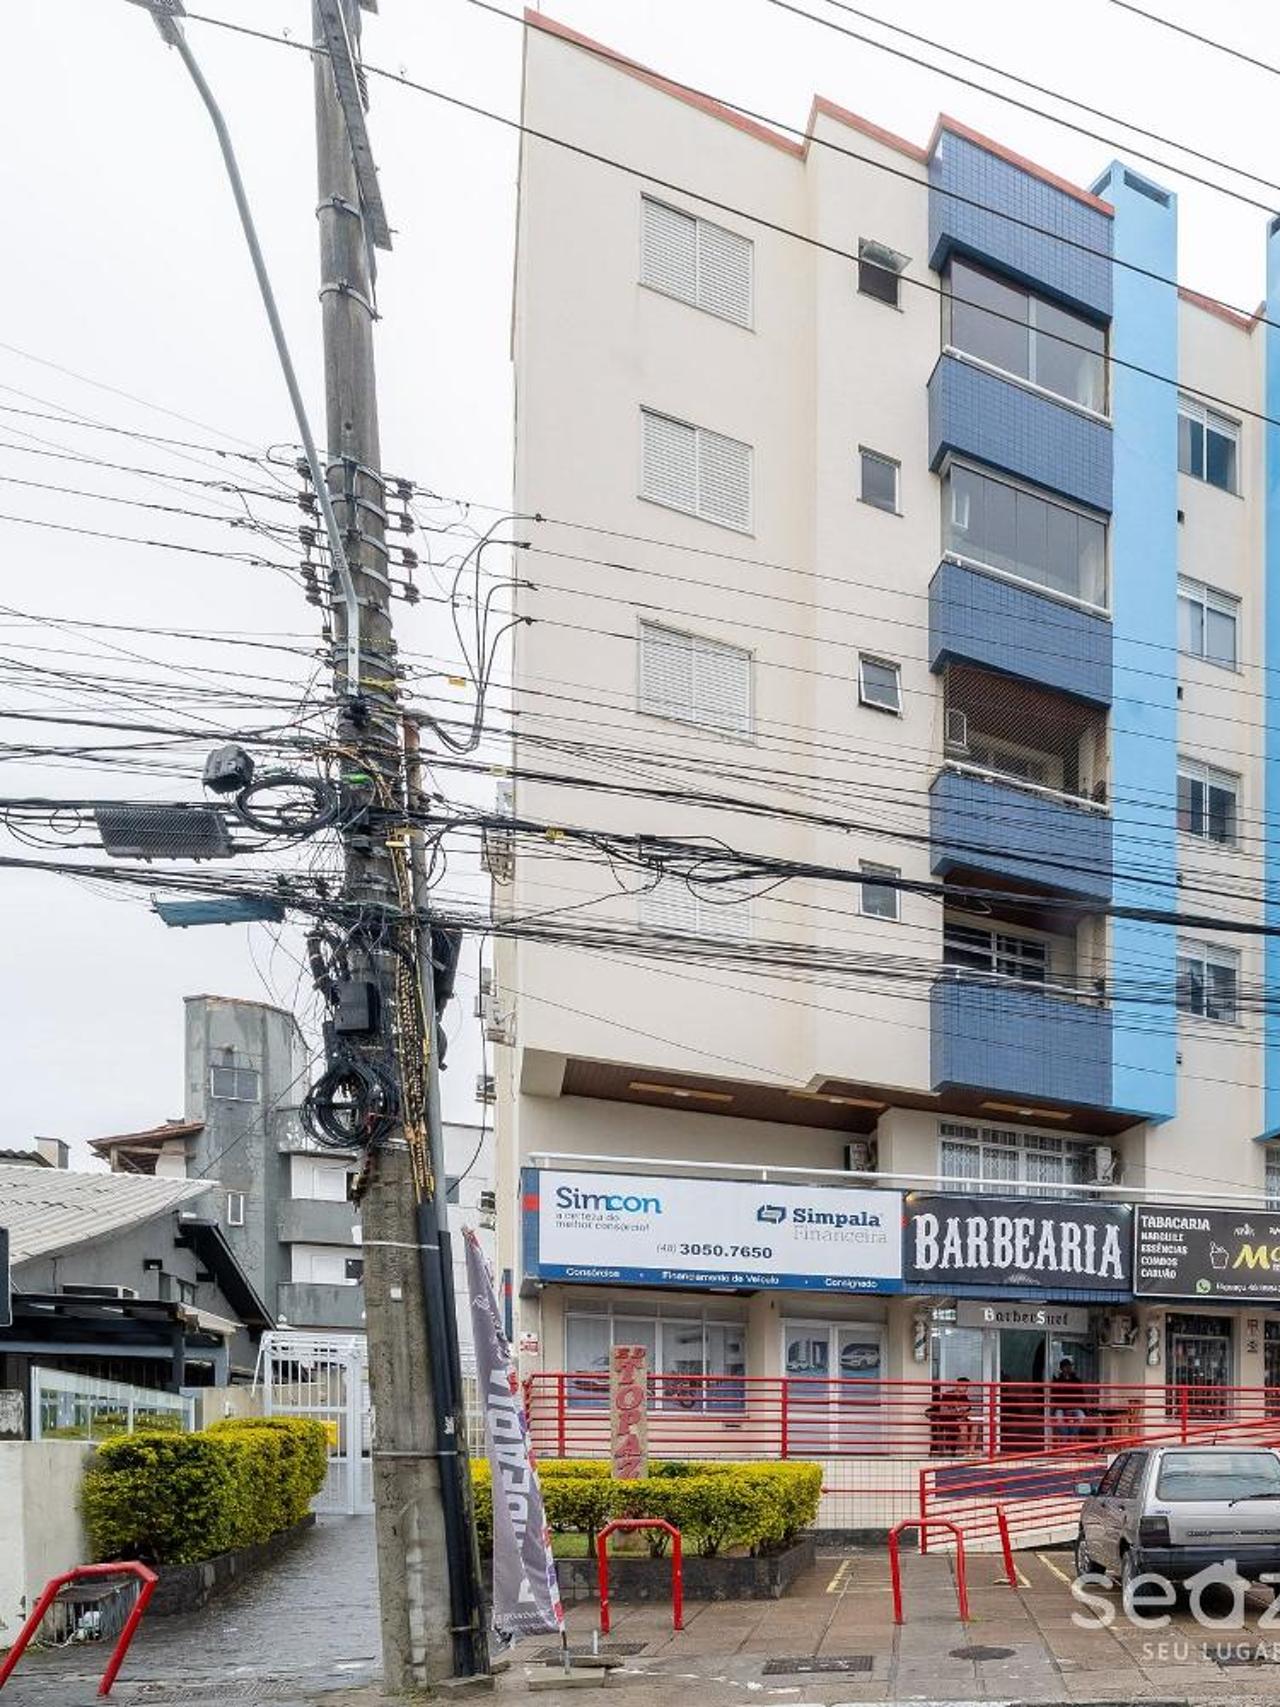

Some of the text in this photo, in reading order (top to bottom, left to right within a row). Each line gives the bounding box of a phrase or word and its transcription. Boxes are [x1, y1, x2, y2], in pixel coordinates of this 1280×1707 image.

[556, 1186, 662, 1214] Simcon
[792, 1207, 881, 1228] Simpala
[1141, 1215, 1211, 1231] TABACARIA
[793, 1225, 888, 1244] Financeira
[680, 1243, 773, 1259] 3050.7650
[913, 1213, 1125, 1280] BARBEARIA
[1141, 1268, 1177, 1279] CARVÃO
[824, 1277, 878, 1289] Consignado
